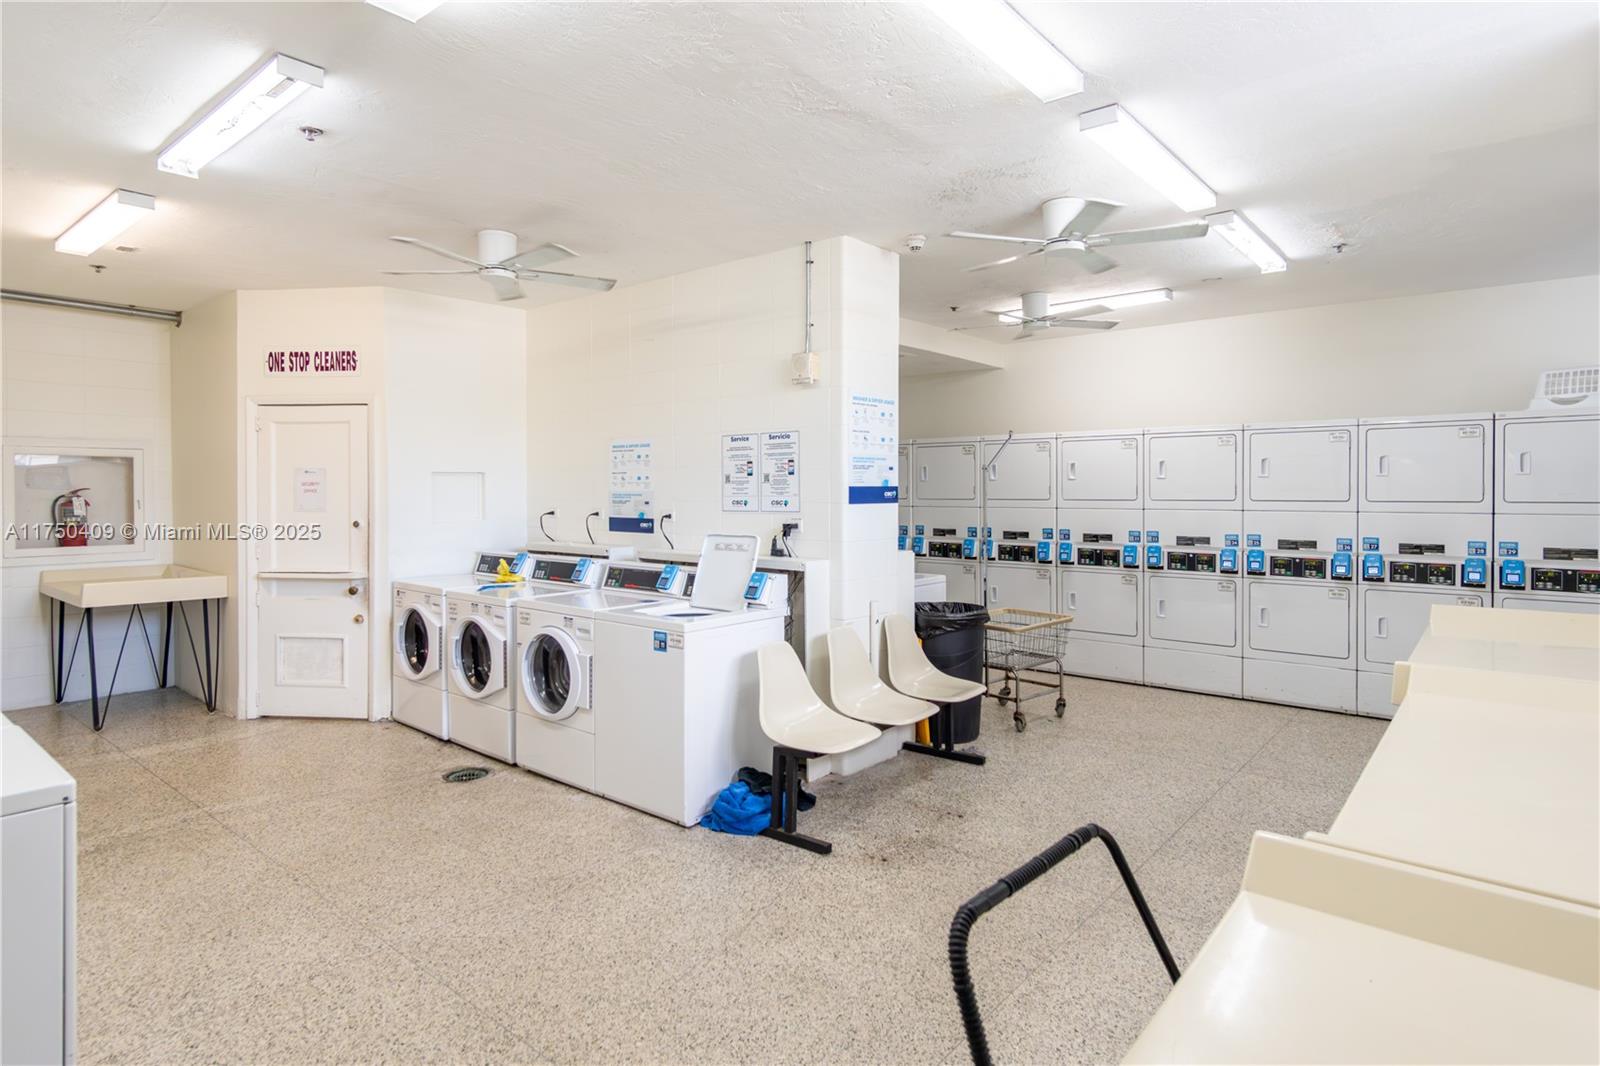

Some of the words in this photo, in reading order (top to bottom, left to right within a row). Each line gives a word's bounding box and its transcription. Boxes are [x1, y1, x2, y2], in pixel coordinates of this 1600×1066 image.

[267, 351, 285, 373] ONE
[288, 351, 310, 373] STOP
[313, 350, 357, 372] CLEANERS
